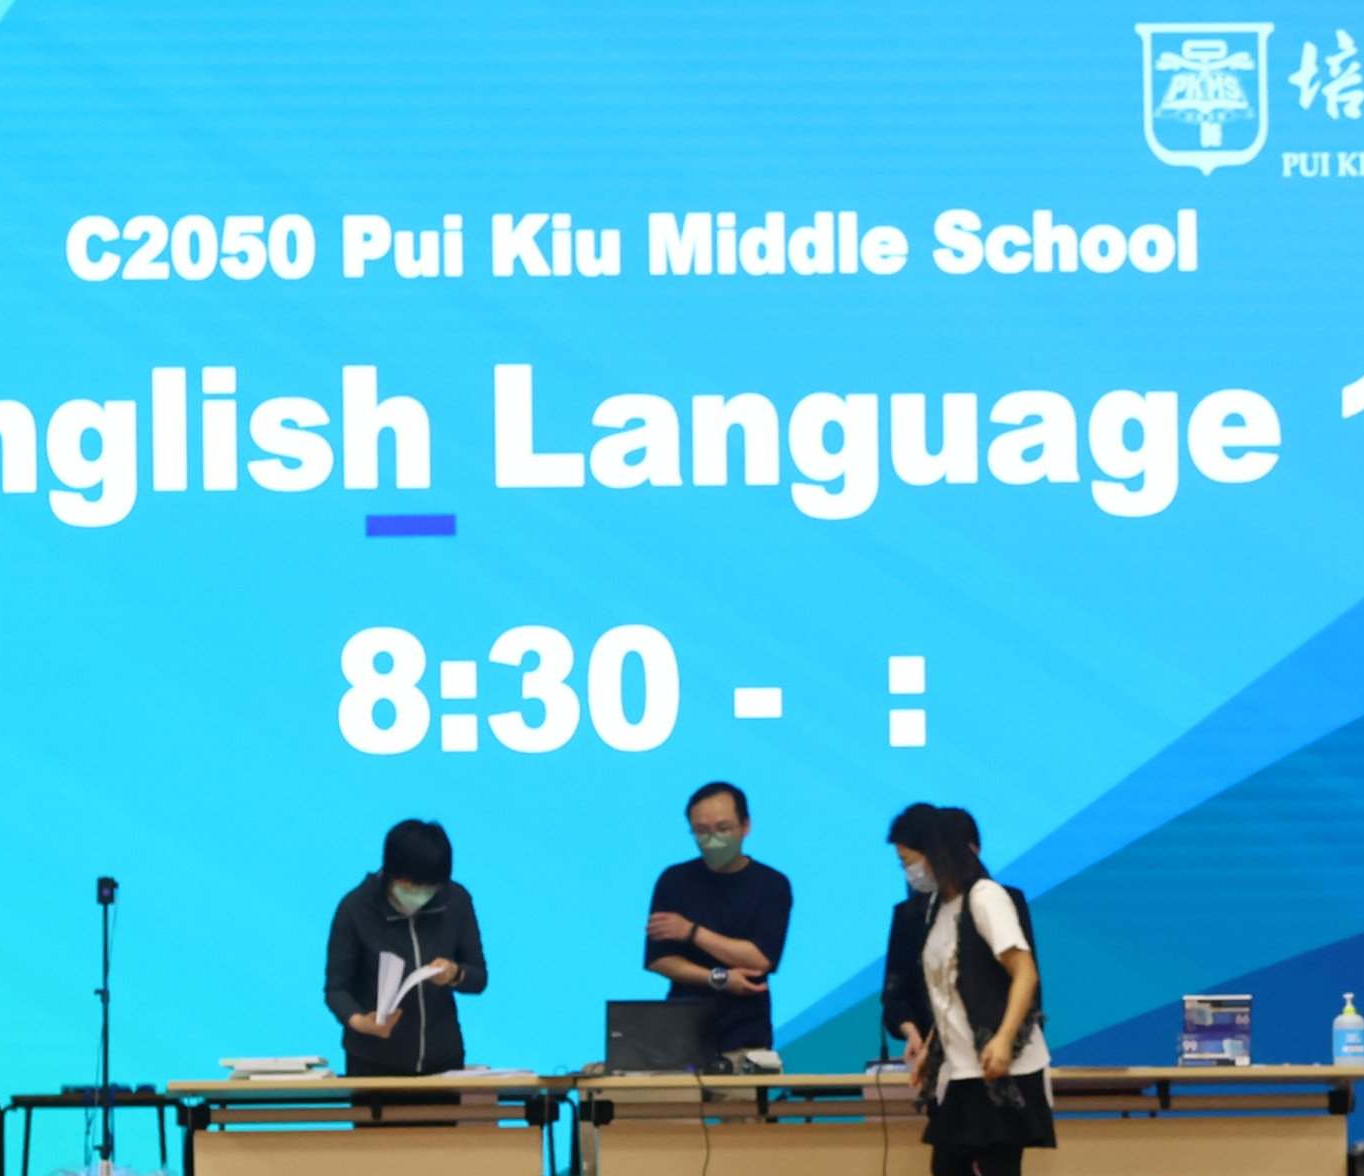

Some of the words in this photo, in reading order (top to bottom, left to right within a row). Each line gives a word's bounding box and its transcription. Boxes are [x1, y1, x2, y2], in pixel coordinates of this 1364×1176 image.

[1282, 152, 1332, 179] PUI
[66, 214, 318, 283] C2050
[342, 214, 466, 280] Pui
[492, 213, 623, 279] Kiu
[648, 211, 911, 278] Middle
[932, 209, 1200, 276] School
[494, 365, 1283, 522] Language
[338, 625, 682, 757] 8:30
[734, 687, 784, 720] -
[888, 656, 928, 749] :
